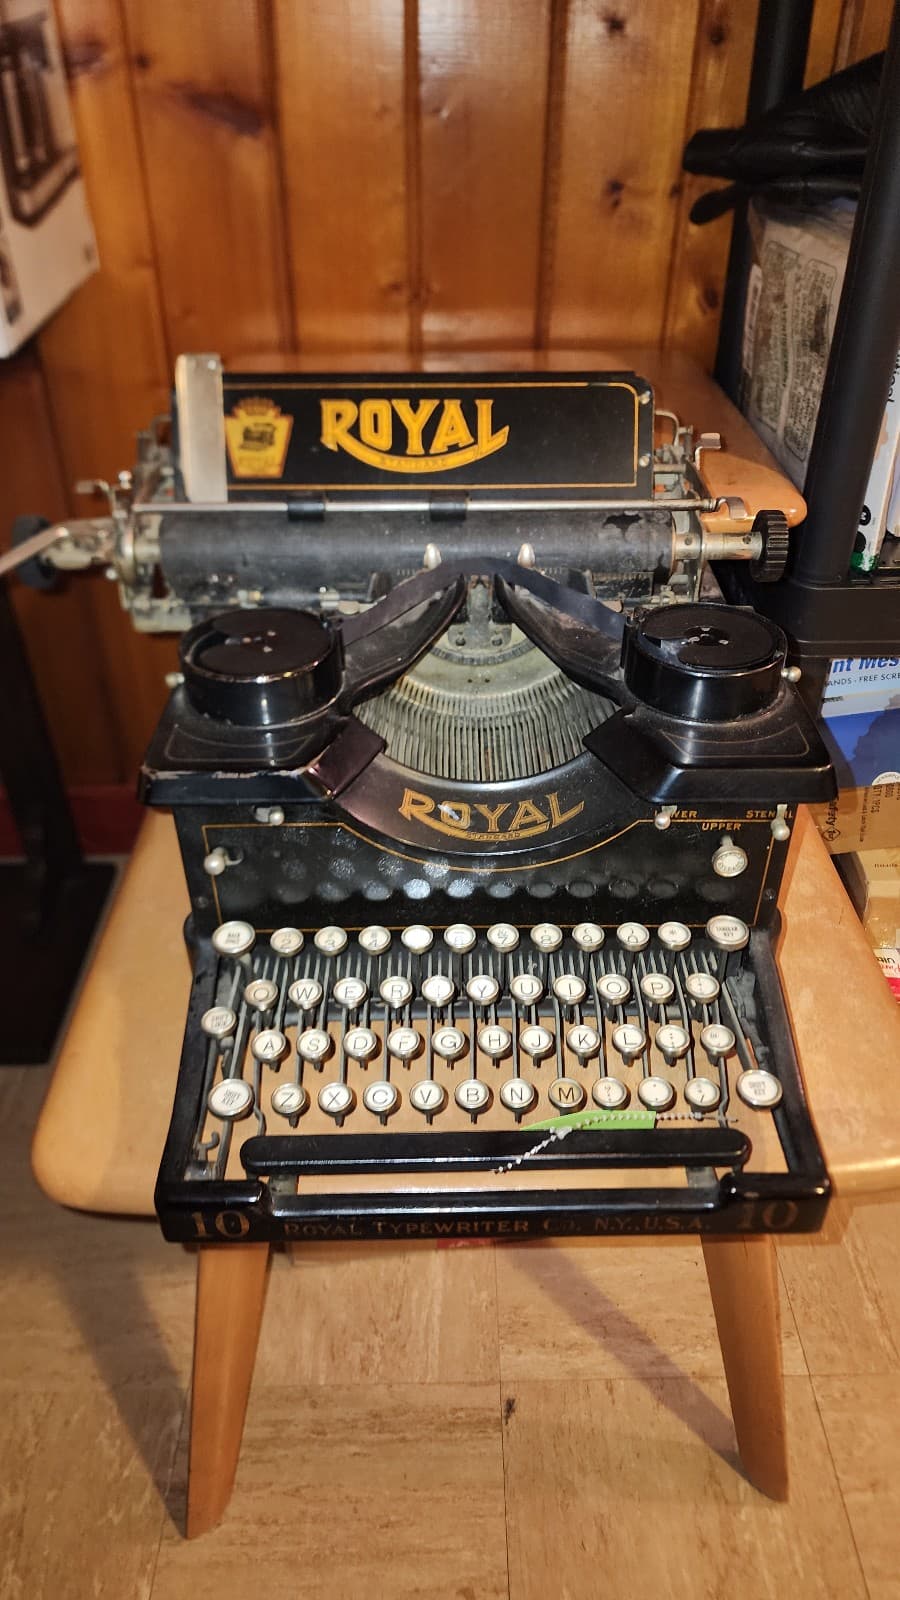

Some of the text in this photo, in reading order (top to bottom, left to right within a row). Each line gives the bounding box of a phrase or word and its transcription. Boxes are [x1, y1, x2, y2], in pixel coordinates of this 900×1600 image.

[319, 398, 510, 463] ROYAL
[398, 788, 585, 836] ROYAL
[745, 810, 794, 819] STENIL
[465, 830, 522, 841] STANDARD
[701, 822, 742, 831] UPPER
[280, 939, 291, 949] 2
[296, 987, 314, 1000] W
[345, 985, 358, 999] E
[391, 984, 404, 999] R
[477, 985, 488, 998] Y
[520, 982, 534, 995] U
[607, 981, 622, 993] O
[650, 983, 664, 995] P
[263, 1032, 638, 1052] A S D F G H J K L
[279, 1092, 295, 1108] Z
[327, 1091, 341, 1107] X
[372, 1090, 388, 1104] C
[420, 1089, 432, 1104] V
[466, 1088, 480, 1101] B
[510, 1088, 523, 1101] N
[558, 1087, 575, 1102] M
[191, 1210, 250, 1239] 10
[284, 1220, 362, 1235] ROYAL
[372, 1219, 529, 1234] TYPEWRITER
[736, 1200, 798, 1230] 10
